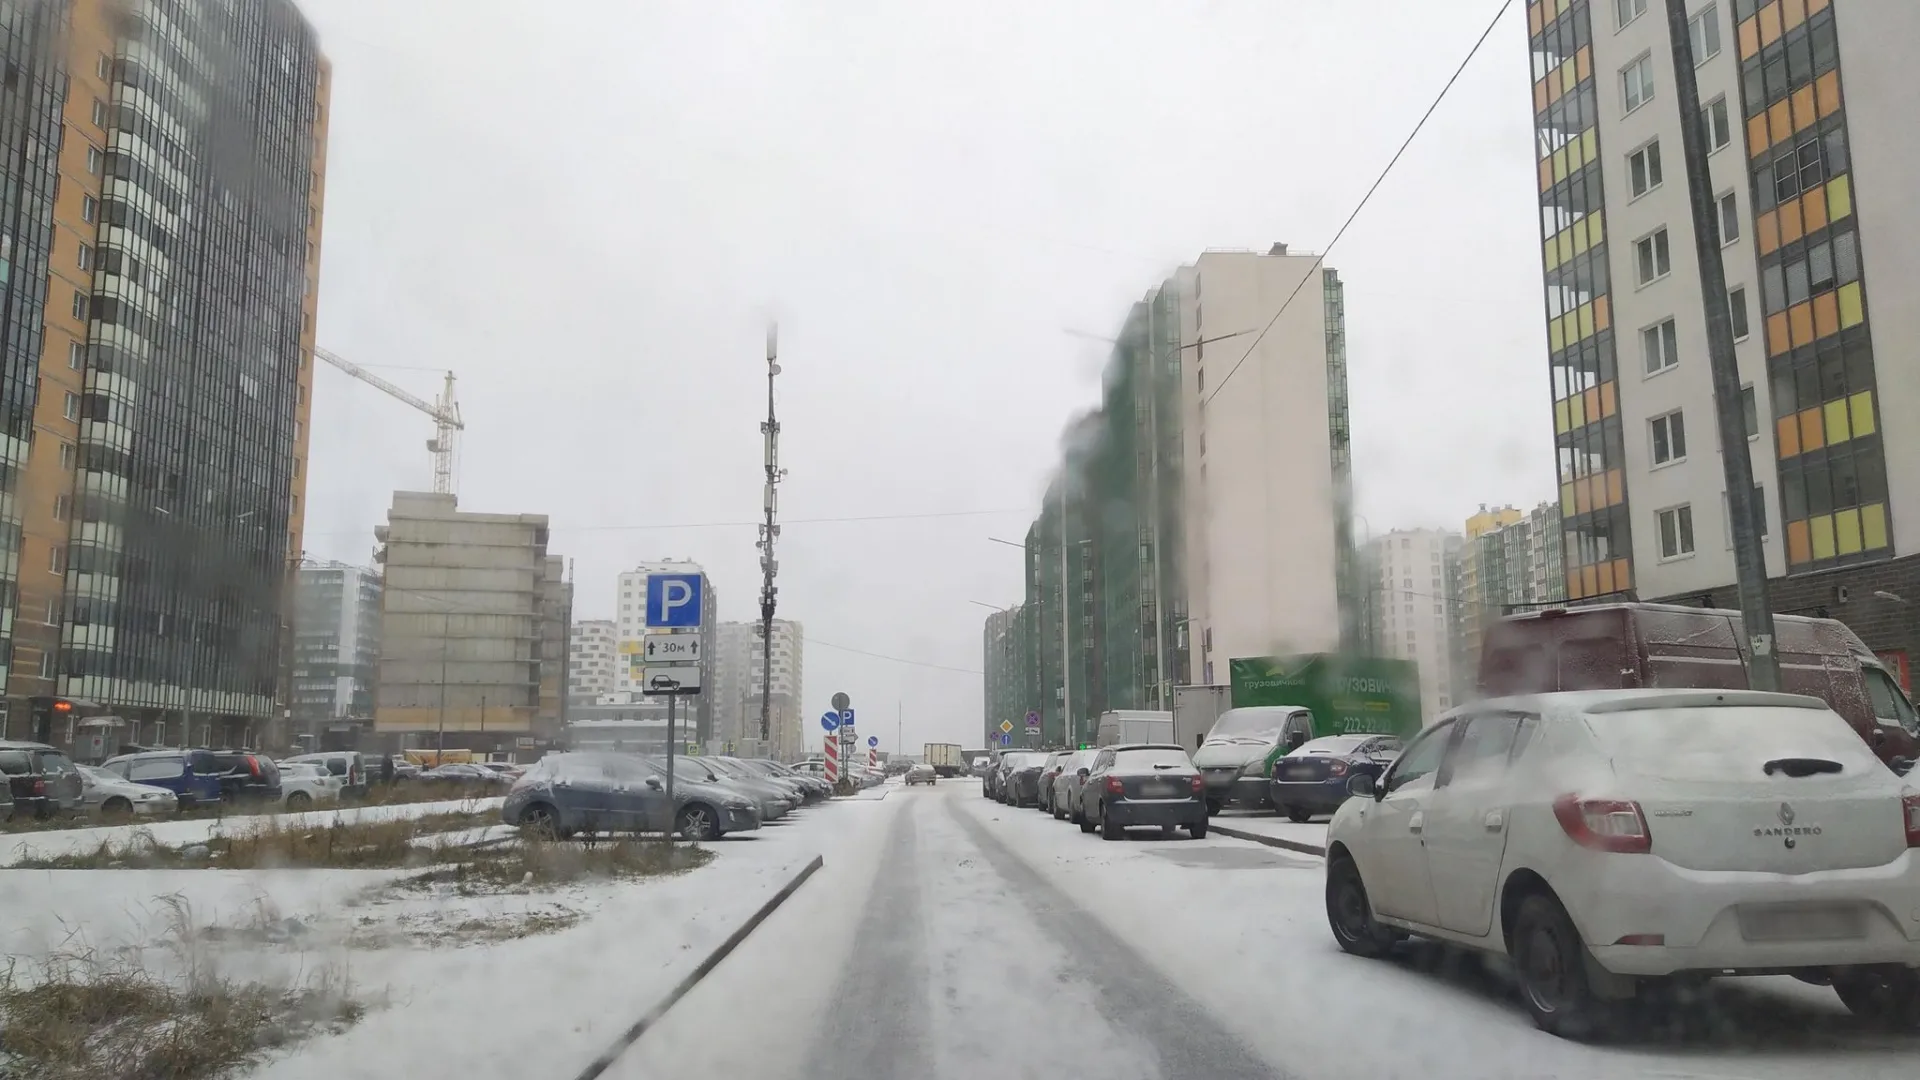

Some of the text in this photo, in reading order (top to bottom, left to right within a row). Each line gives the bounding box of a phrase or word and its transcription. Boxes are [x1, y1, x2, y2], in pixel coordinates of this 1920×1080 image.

[661, 580, 692, 622] P
[843, 711, 852, 724] P
[1753, 827, 1822, 837] SANDERO
